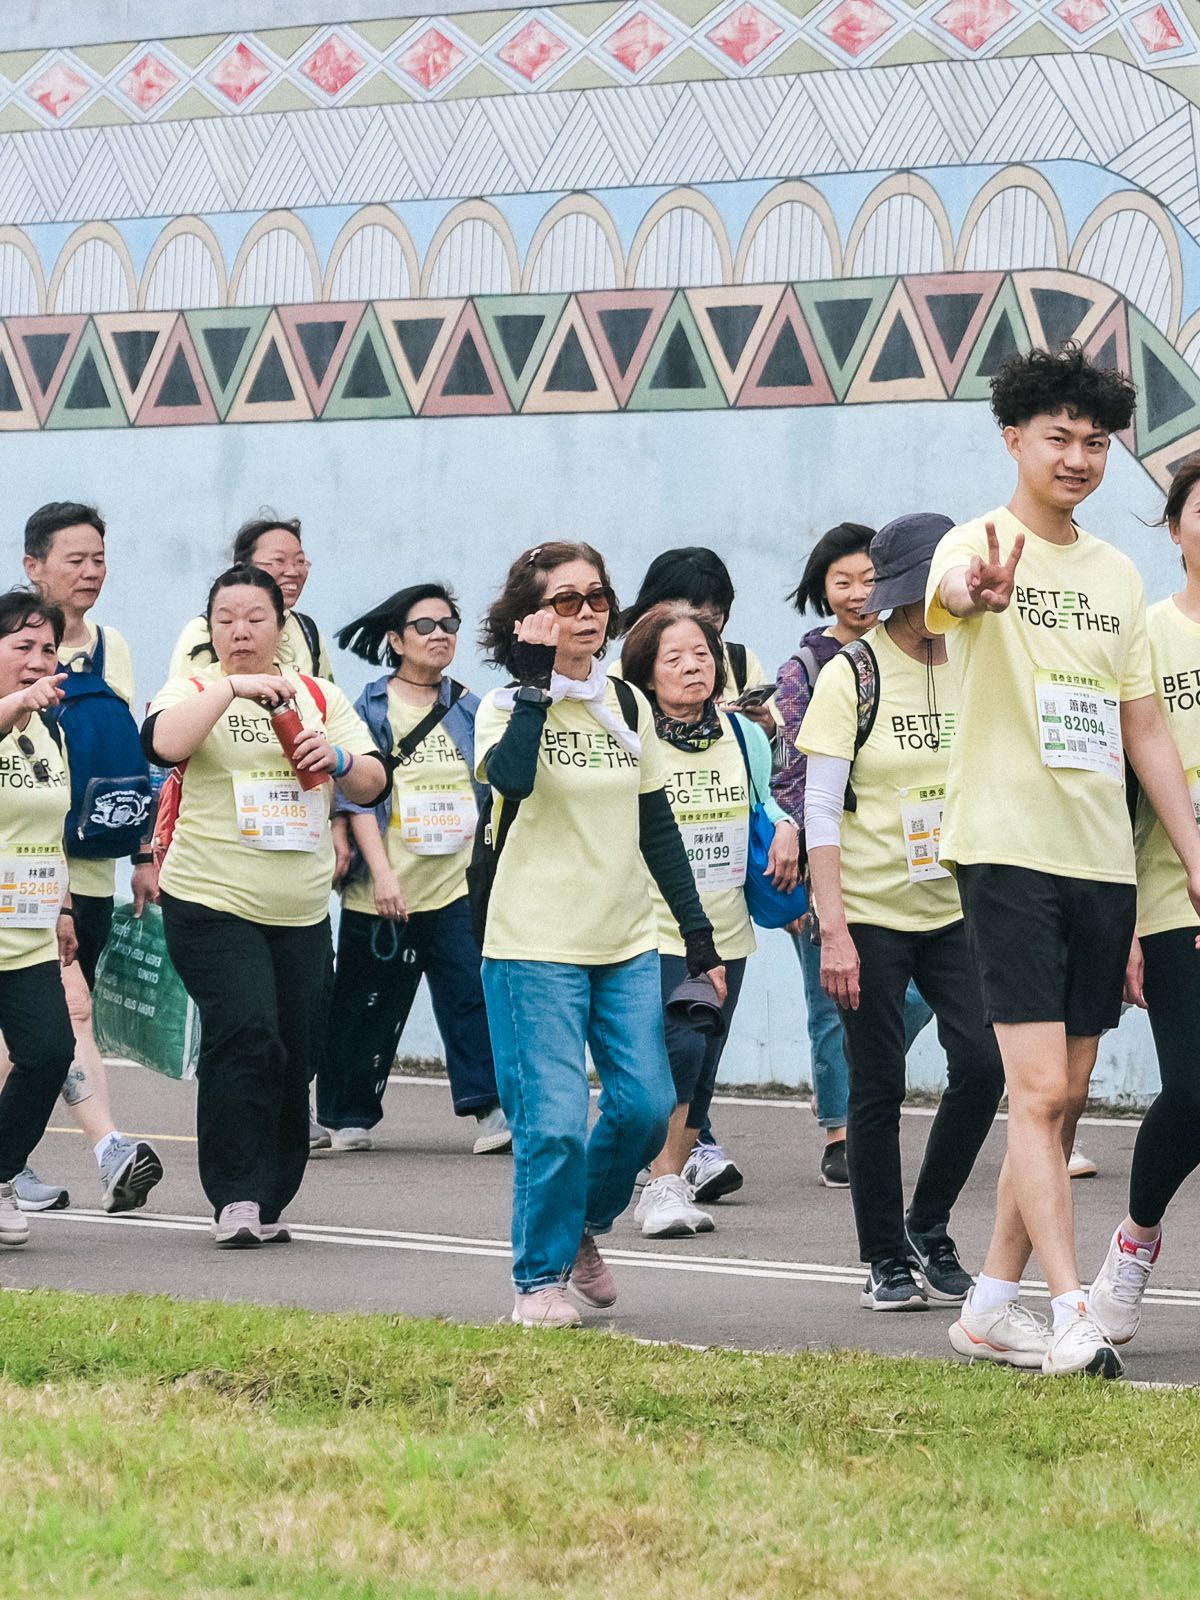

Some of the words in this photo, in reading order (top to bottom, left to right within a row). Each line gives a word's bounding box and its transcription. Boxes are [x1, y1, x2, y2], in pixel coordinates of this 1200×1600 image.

[1016, 586, 1090, 610] BETTER
[1018, 606, 1120, 635] TOGETHER
[892, 713, 955, 732] BETTE
[1064, 715, 1105, 736] 82094
[544, 748, 639, 768] TOGETHE
[262, 805, 306, 818] 52485
[687, 846, 730, 861] 80199
[19, 882, 59, 895] 52486
